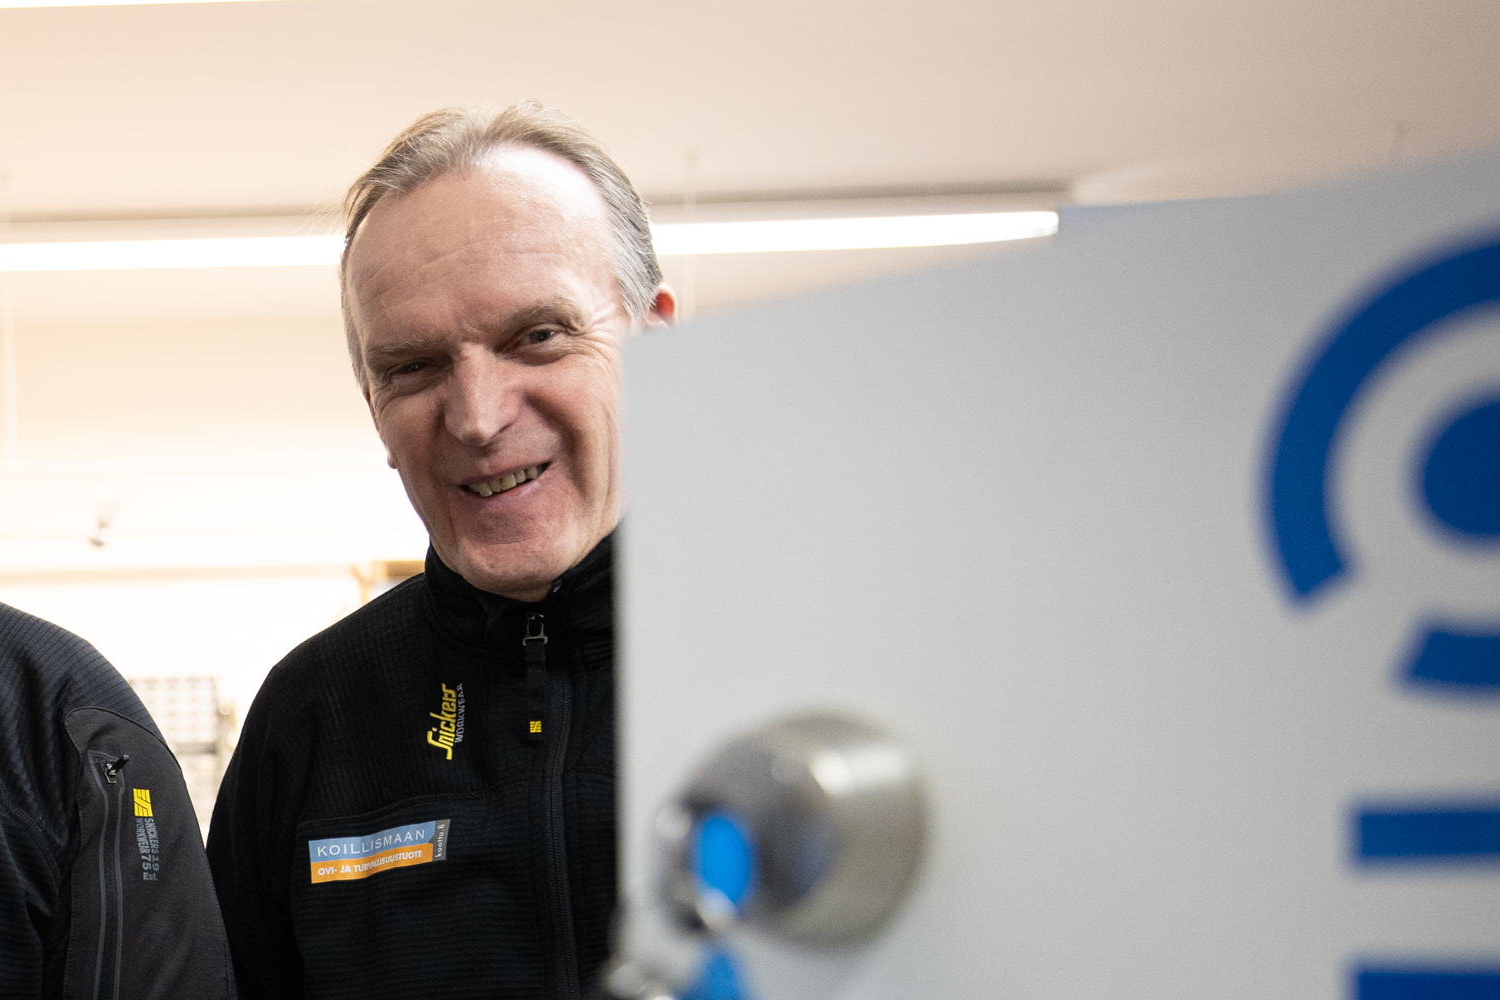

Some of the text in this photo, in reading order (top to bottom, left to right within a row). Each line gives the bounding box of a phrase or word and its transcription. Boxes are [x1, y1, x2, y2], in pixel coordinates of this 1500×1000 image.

[426, 683, 457, 761] Snickers
[454, 682, 466, 744] WORKWEAR
[135, 817, 150, 854] WORKWEAR
[144, 817, 160, 855] SNICKERS
[317, 829, 426, 858] KOILLISMAAN
[142, 871, 159, 881] Est.
[339, 865, 352, 874] JA
[353, 849, 423, 873] TURVALLISUUSTUOTE
